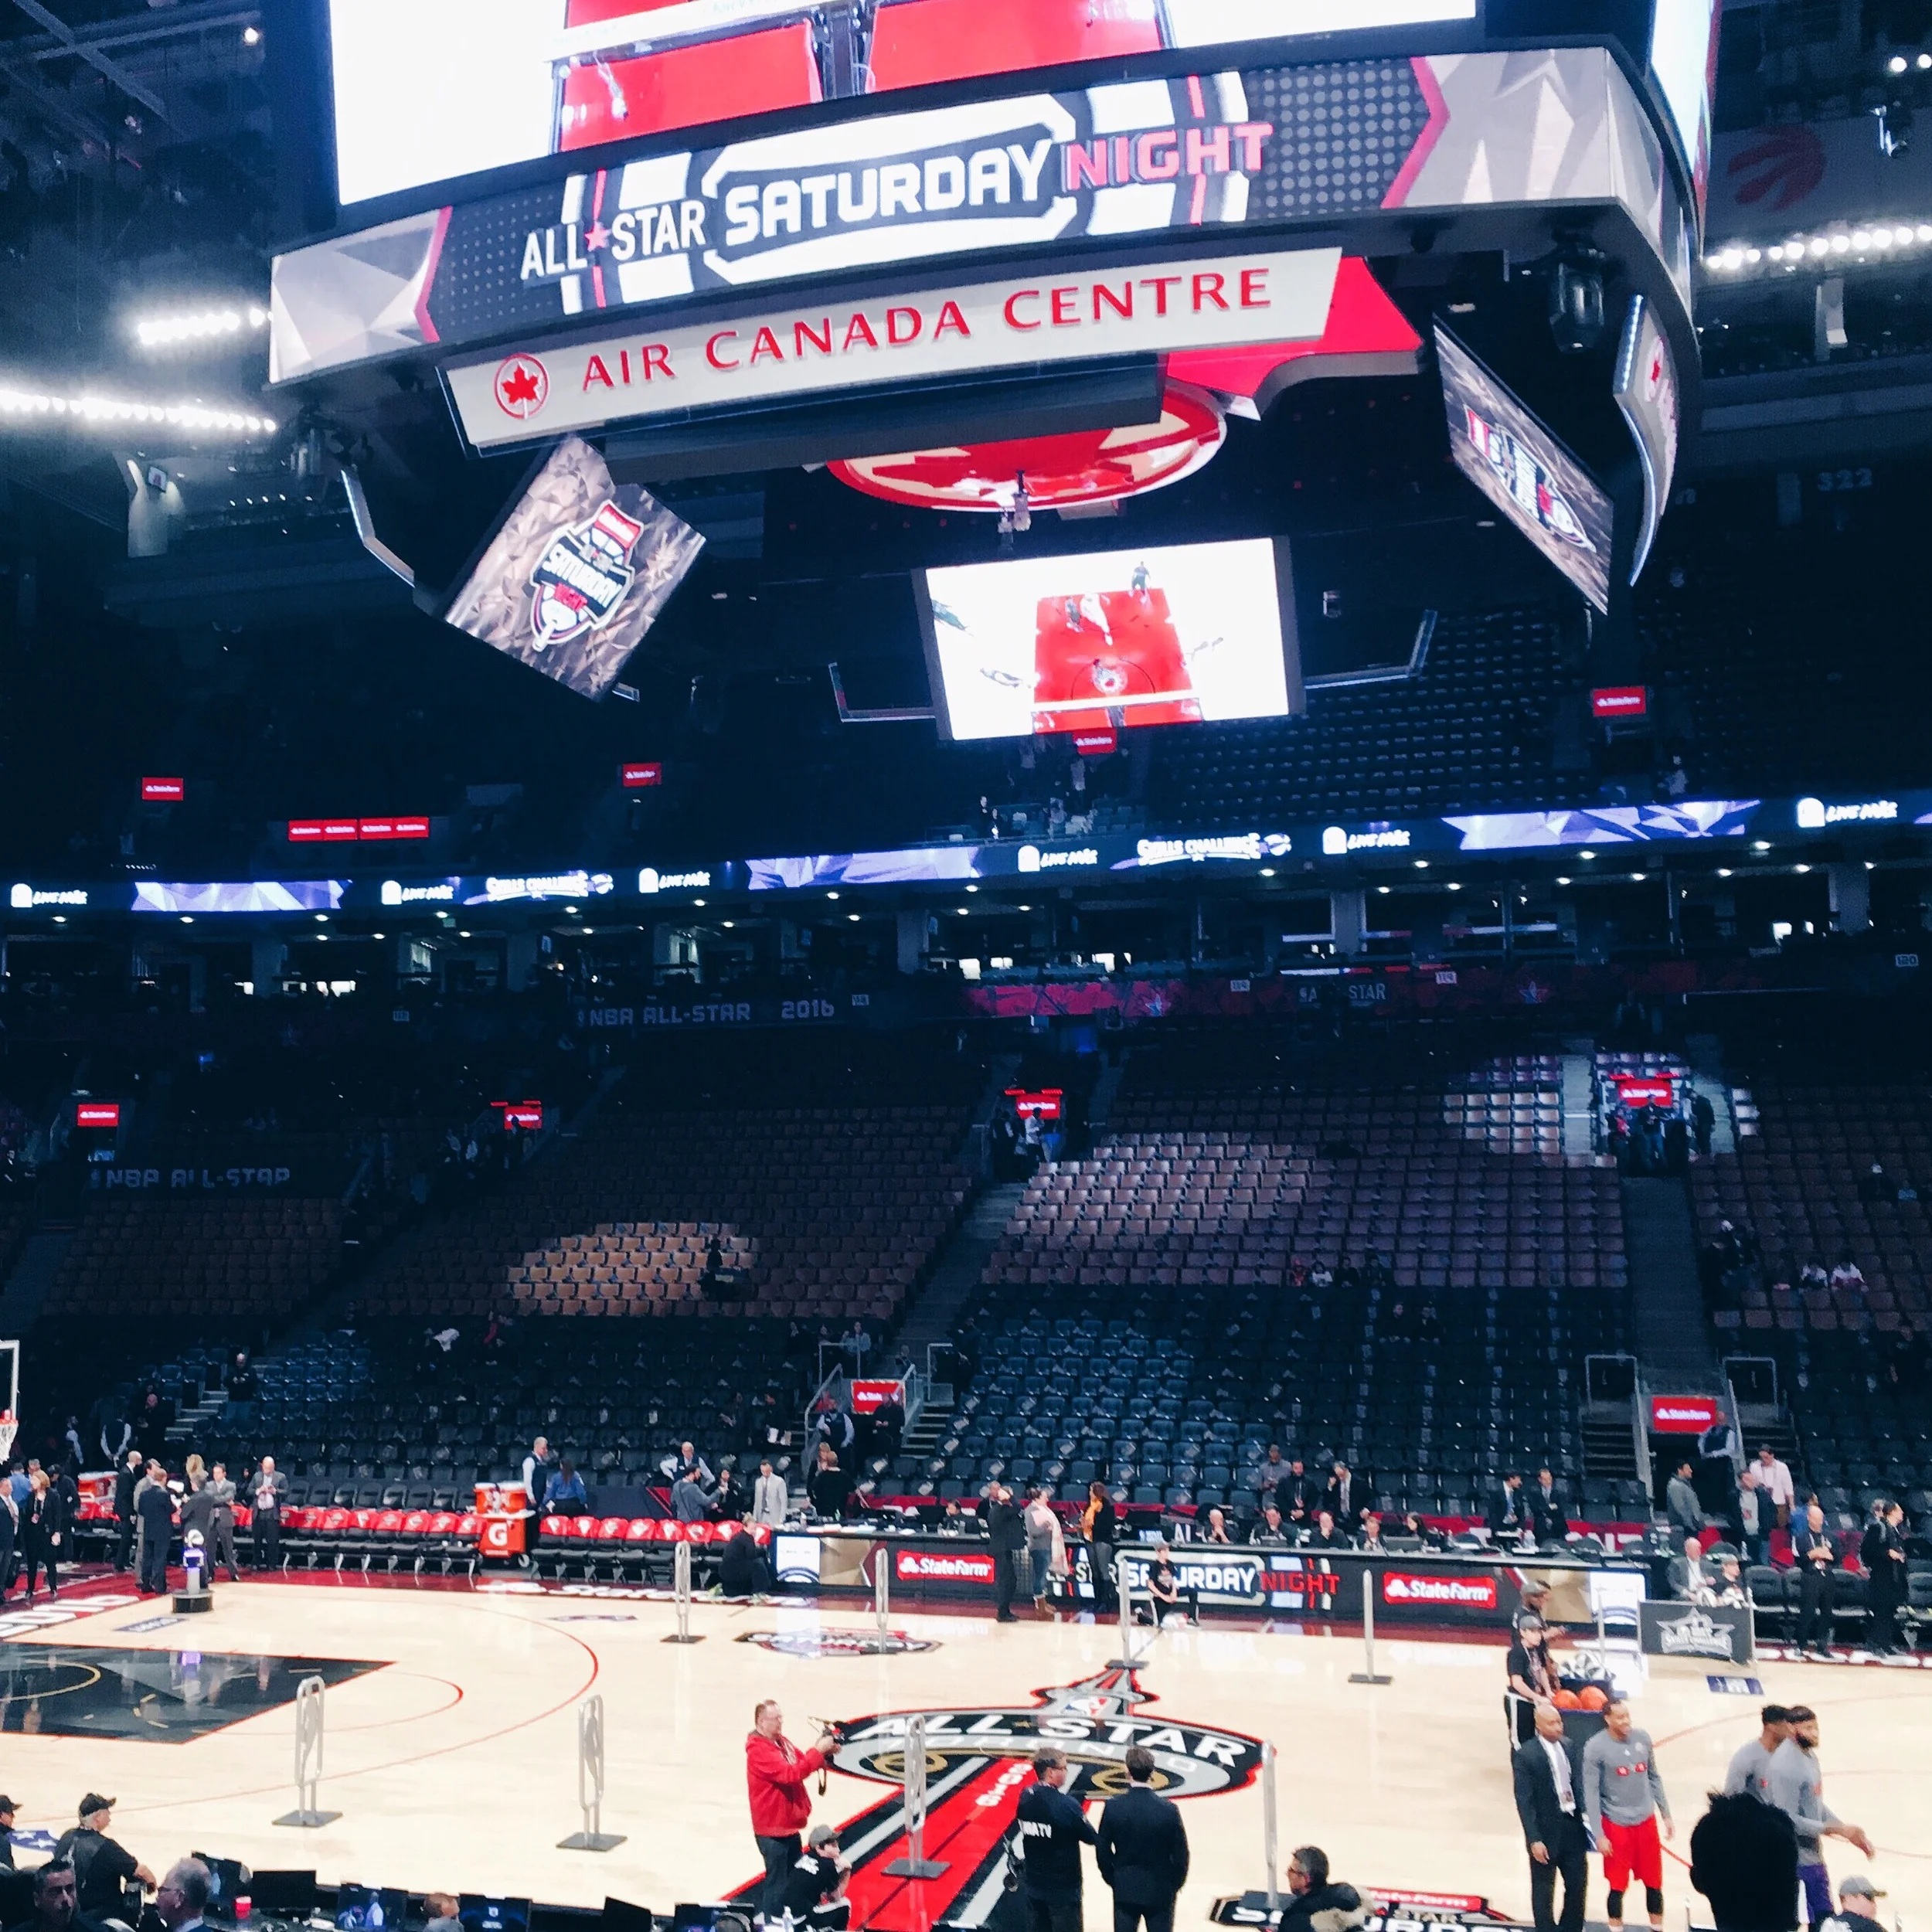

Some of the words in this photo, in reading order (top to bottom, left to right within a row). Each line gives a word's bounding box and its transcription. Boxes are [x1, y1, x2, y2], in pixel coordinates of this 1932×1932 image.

[520, 223, 588, 280] ALL
[611, 199, 706, 261] STAR
[725, 139, 1053, 247] SATURDAY
[1066, 123, 1274, 191] NIGHT
[583, 343, 675, 391] AIR
[705, 301, 971, 370] CANADA
[1003, 268, 1270, 331] CENTRE
[590, 1008, 634, 1026] NBA
[781, 999, 835, 1019] 2016
[488, 1522, 508, 1546] G
[920, 1556, 990, 1577] StateFarm
[1260, 1570, 1341, 1595] NIGHT
[1410, 1580, 1488, 1601] StateFarm
[848, 1713, 1013, 1740] ALL
[1038, 1716, 1247, 1768] STAR
